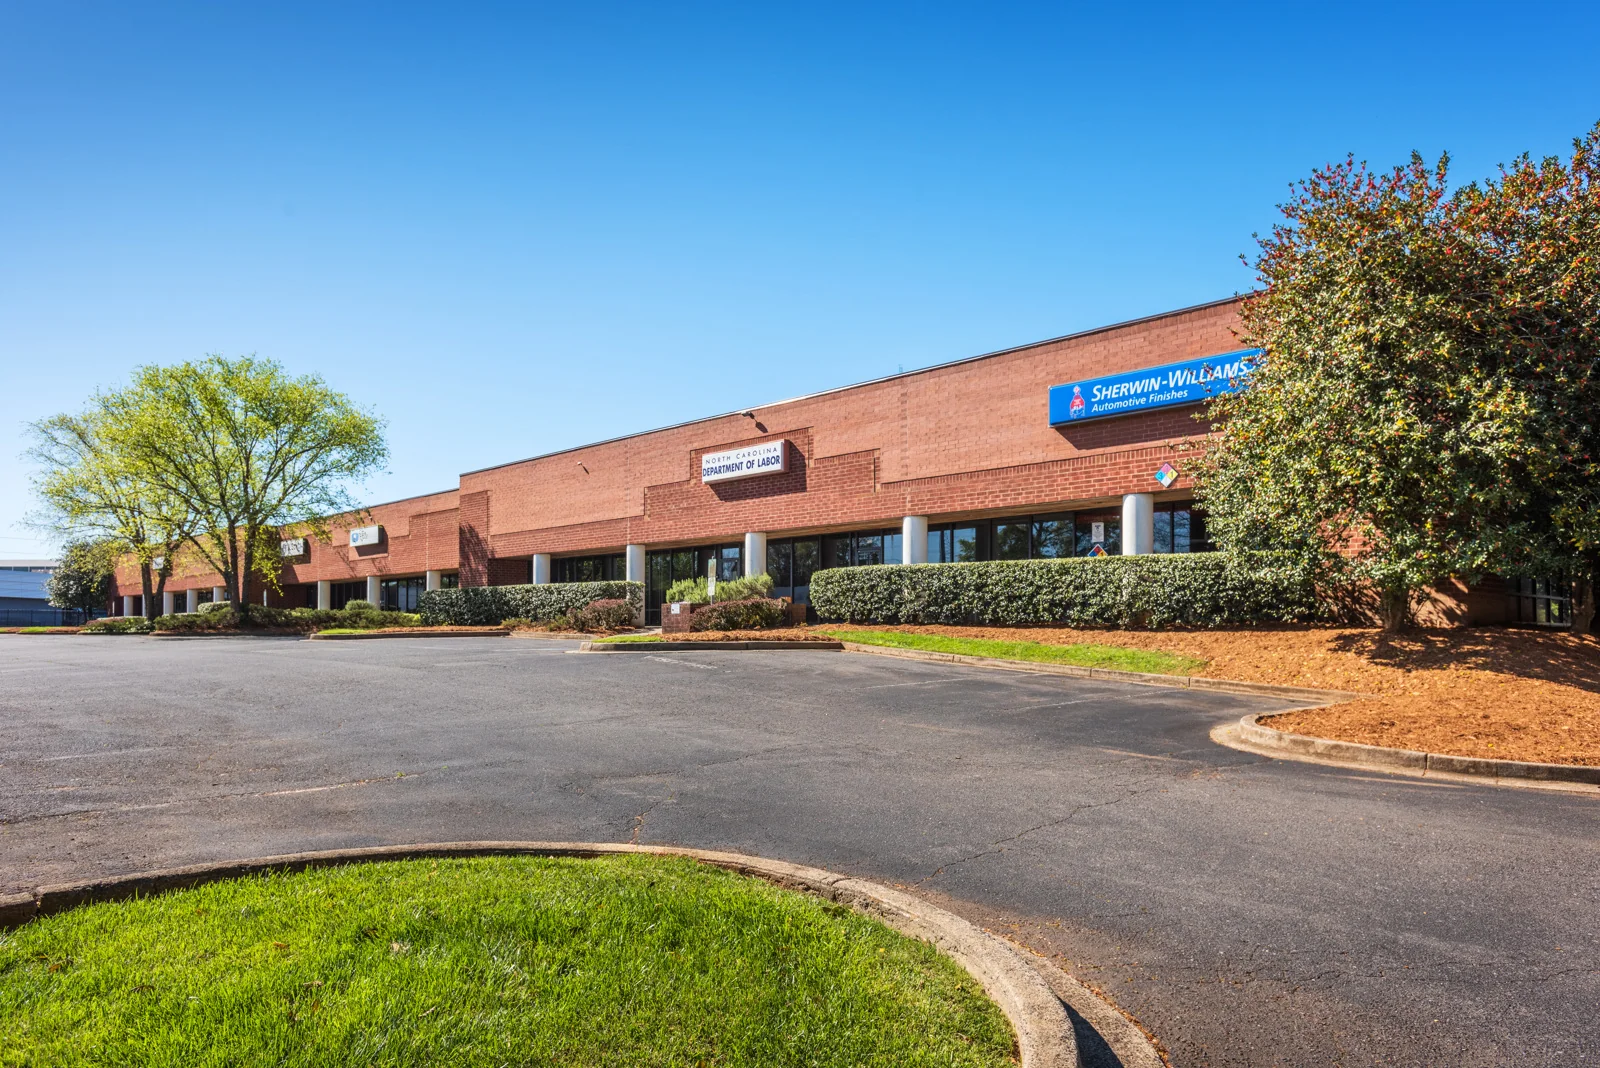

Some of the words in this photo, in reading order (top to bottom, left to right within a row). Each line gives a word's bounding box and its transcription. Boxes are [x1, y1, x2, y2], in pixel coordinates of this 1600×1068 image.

[1091, 396, 1147, 413] Automotive
[1149, 389, 1188, 403] Finishes
[703, 461, 743, 476] DEPARTMENT
[746, 459, 755, 469] OF
[757, 455, 780, 467] LABOR
[706, 456, 731, 464] NORTH
[736, 447, 777, 459] CAROLINA
